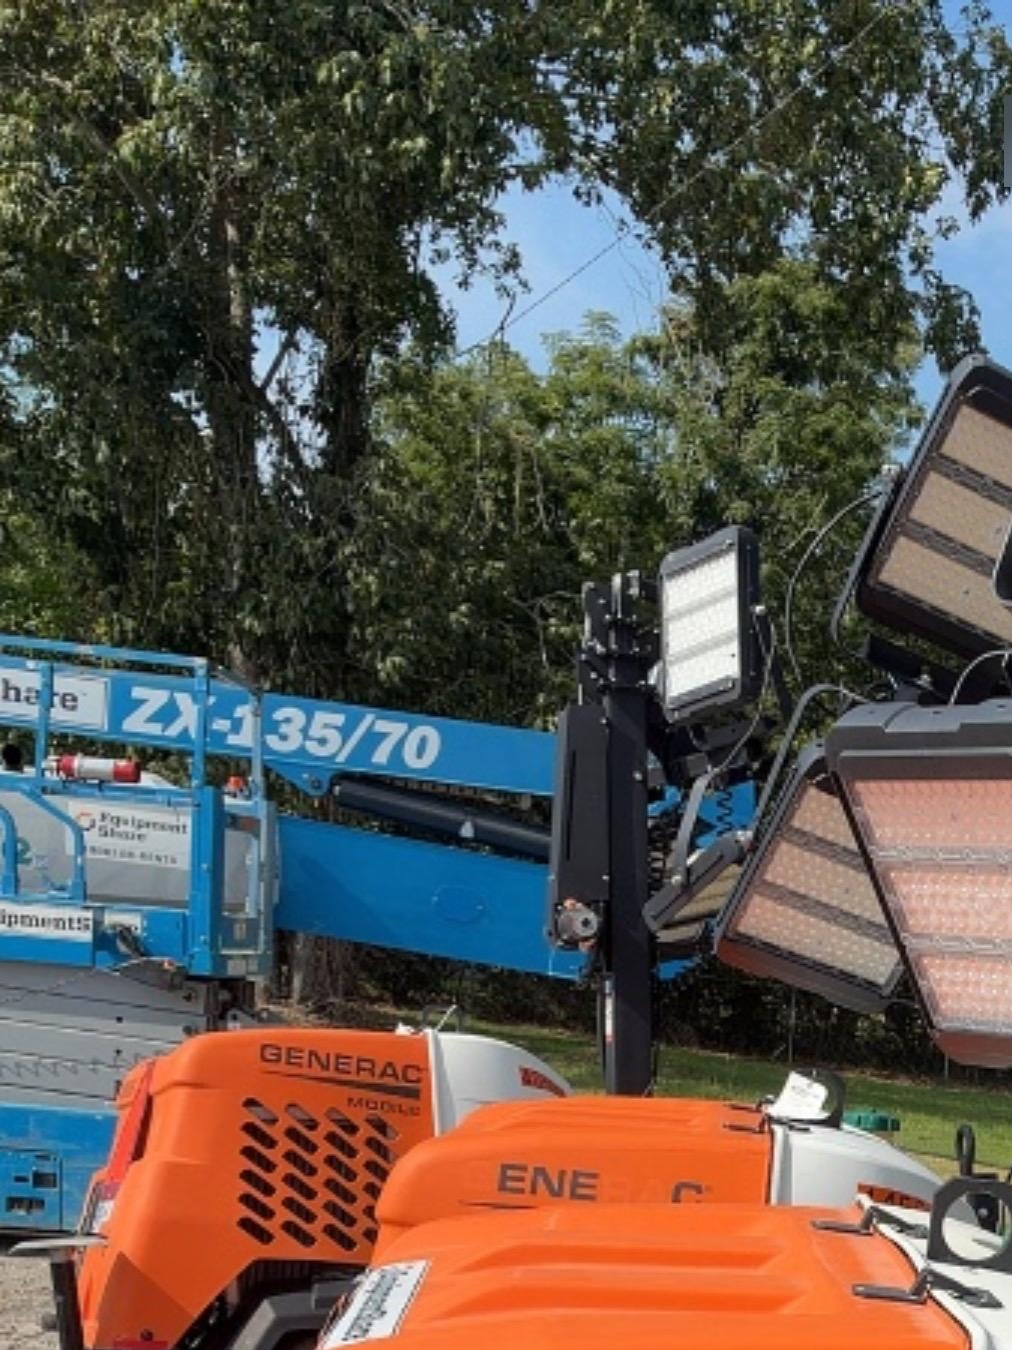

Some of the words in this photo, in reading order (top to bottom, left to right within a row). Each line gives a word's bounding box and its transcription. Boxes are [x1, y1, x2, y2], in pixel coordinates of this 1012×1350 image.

[1, 677, 79, 711] hae
[121, 686, 441, 769] ZX-135/70
[259, 1043, 423, 1084] GENERAC
